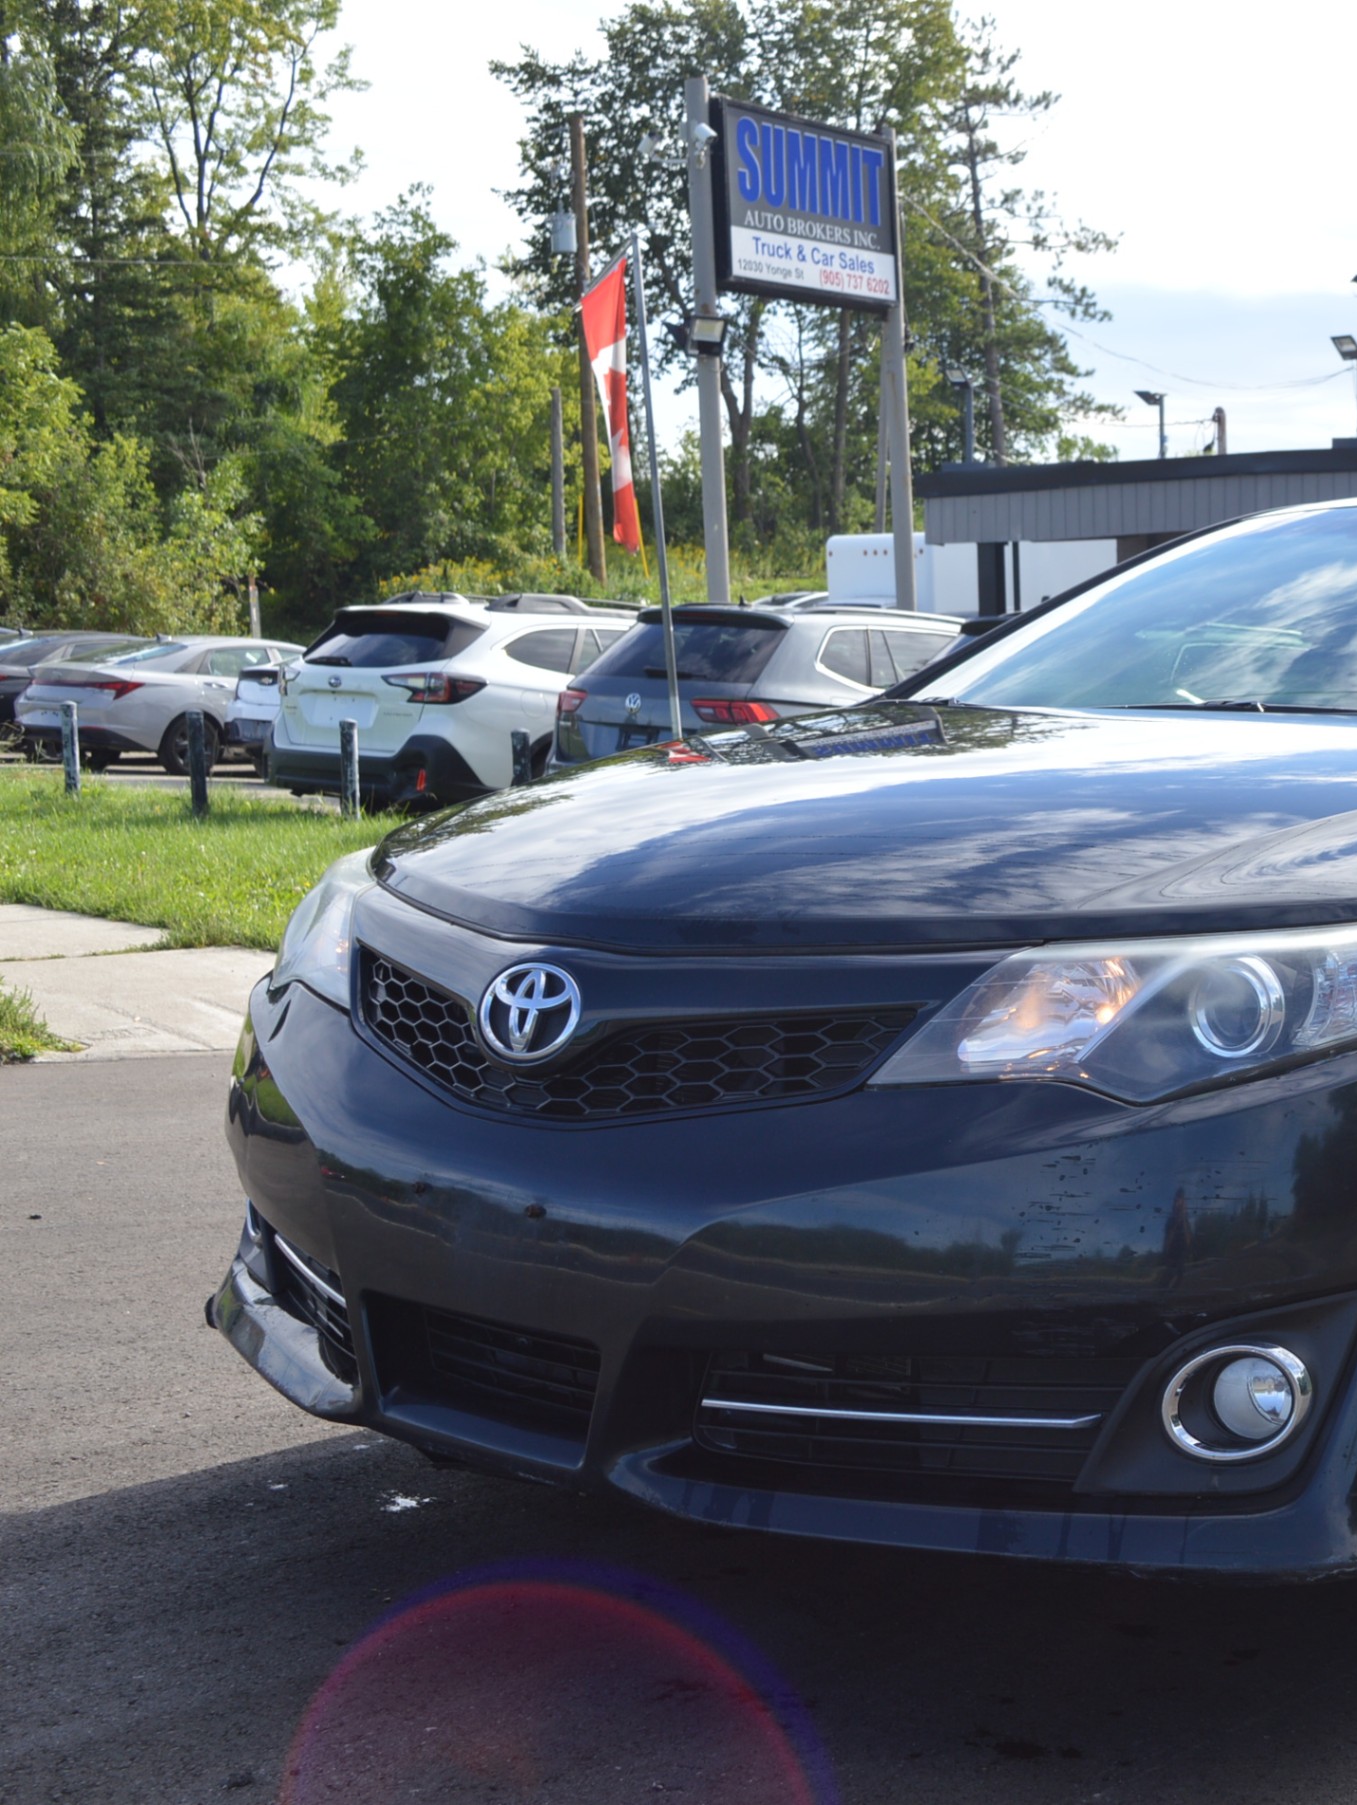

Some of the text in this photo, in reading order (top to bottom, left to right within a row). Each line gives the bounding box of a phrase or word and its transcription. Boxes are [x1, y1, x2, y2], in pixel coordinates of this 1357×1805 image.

[737, 116, 883, 226] SUMMIT
[744, 209, 880, 250] AUTO BROKERS INC.
[738, 258, 763, 274] 12030
[765, 262, 793, 280] Yonge
[752, 236, 875, 275] Truck & Car Sales
[819, 268, 890, 295] (905) 737 6202
